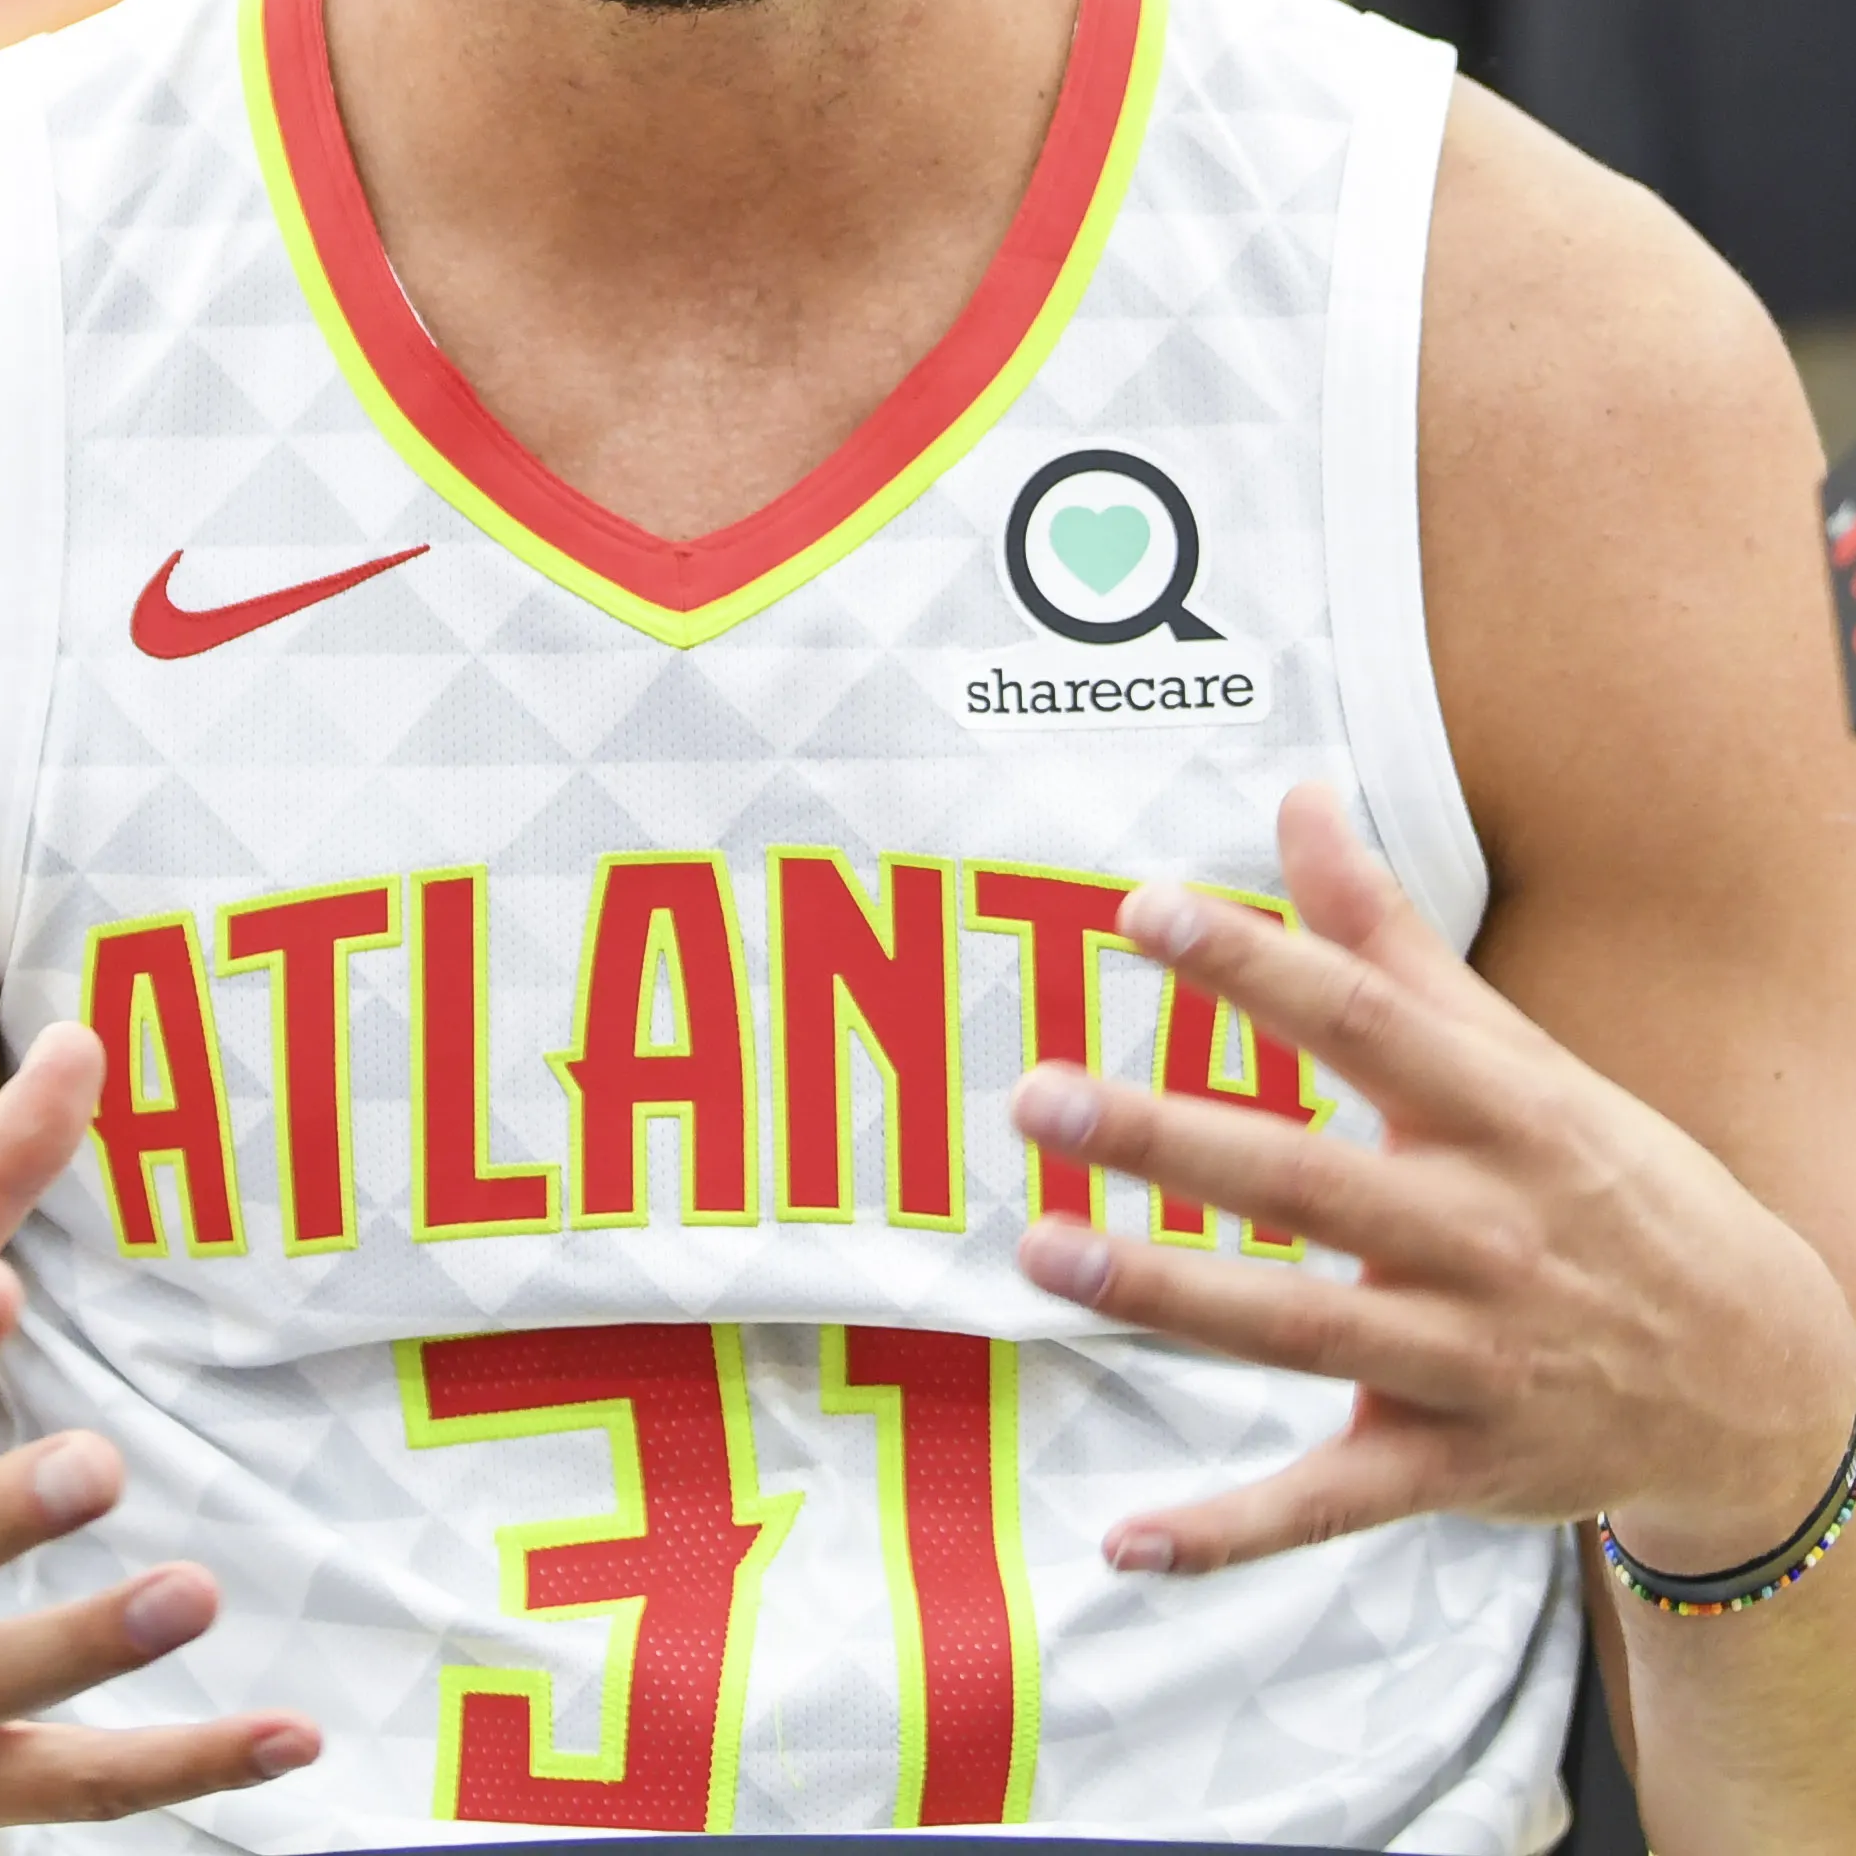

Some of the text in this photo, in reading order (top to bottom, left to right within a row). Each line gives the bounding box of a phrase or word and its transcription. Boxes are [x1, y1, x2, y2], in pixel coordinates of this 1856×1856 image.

[966, 667, 1255, 714] sharecare
[78, 844, 1336, 1262] ATLANTA
[392, 1322, 1040, 1834] 31
